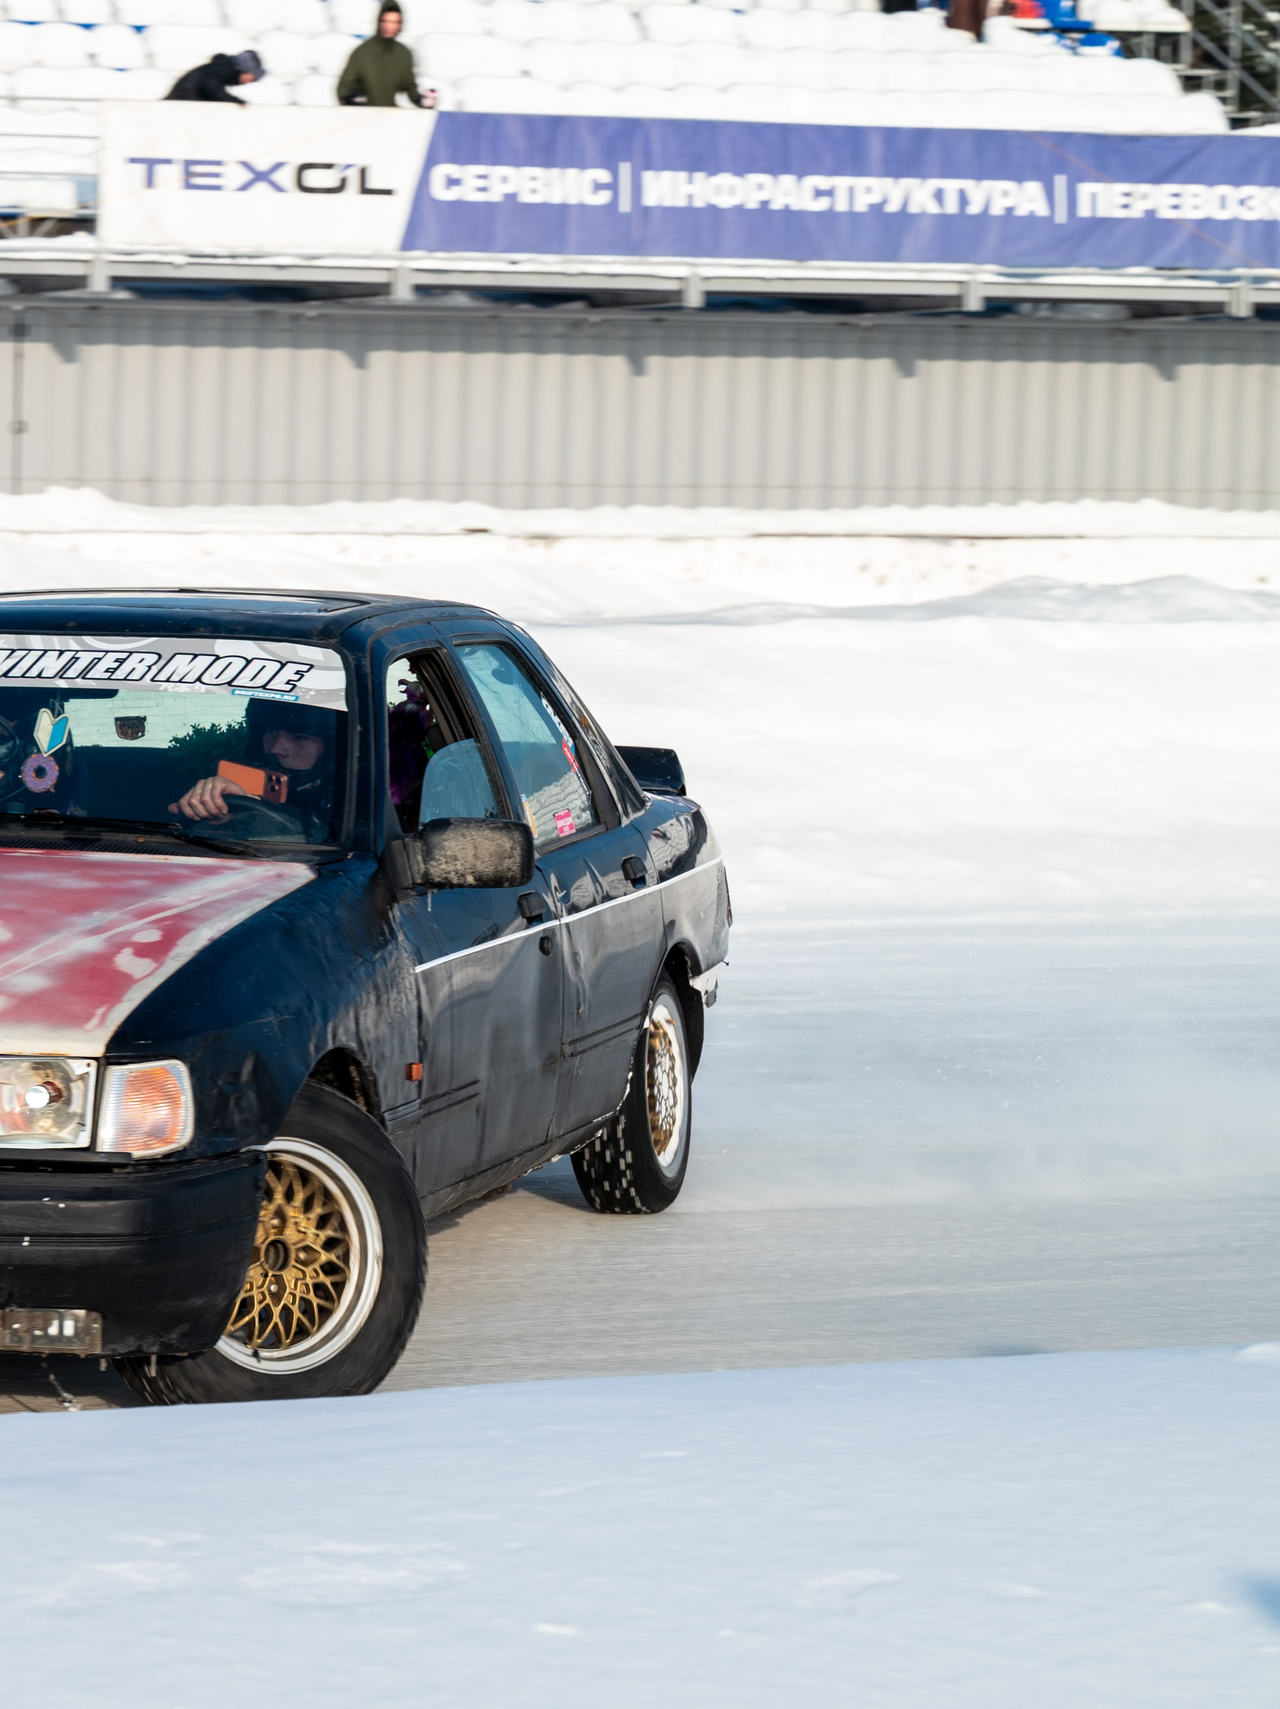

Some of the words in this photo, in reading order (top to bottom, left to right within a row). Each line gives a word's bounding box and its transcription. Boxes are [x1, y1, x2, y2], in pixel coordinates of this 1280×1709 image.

[126, 156, 396, 197] TEXOL
[428, 163, 613, 206] СЕРВИС
[640, 169, 1051, 217] ИНФРАСТРУКТУРА
[150, 652, 314, 692] MODE
